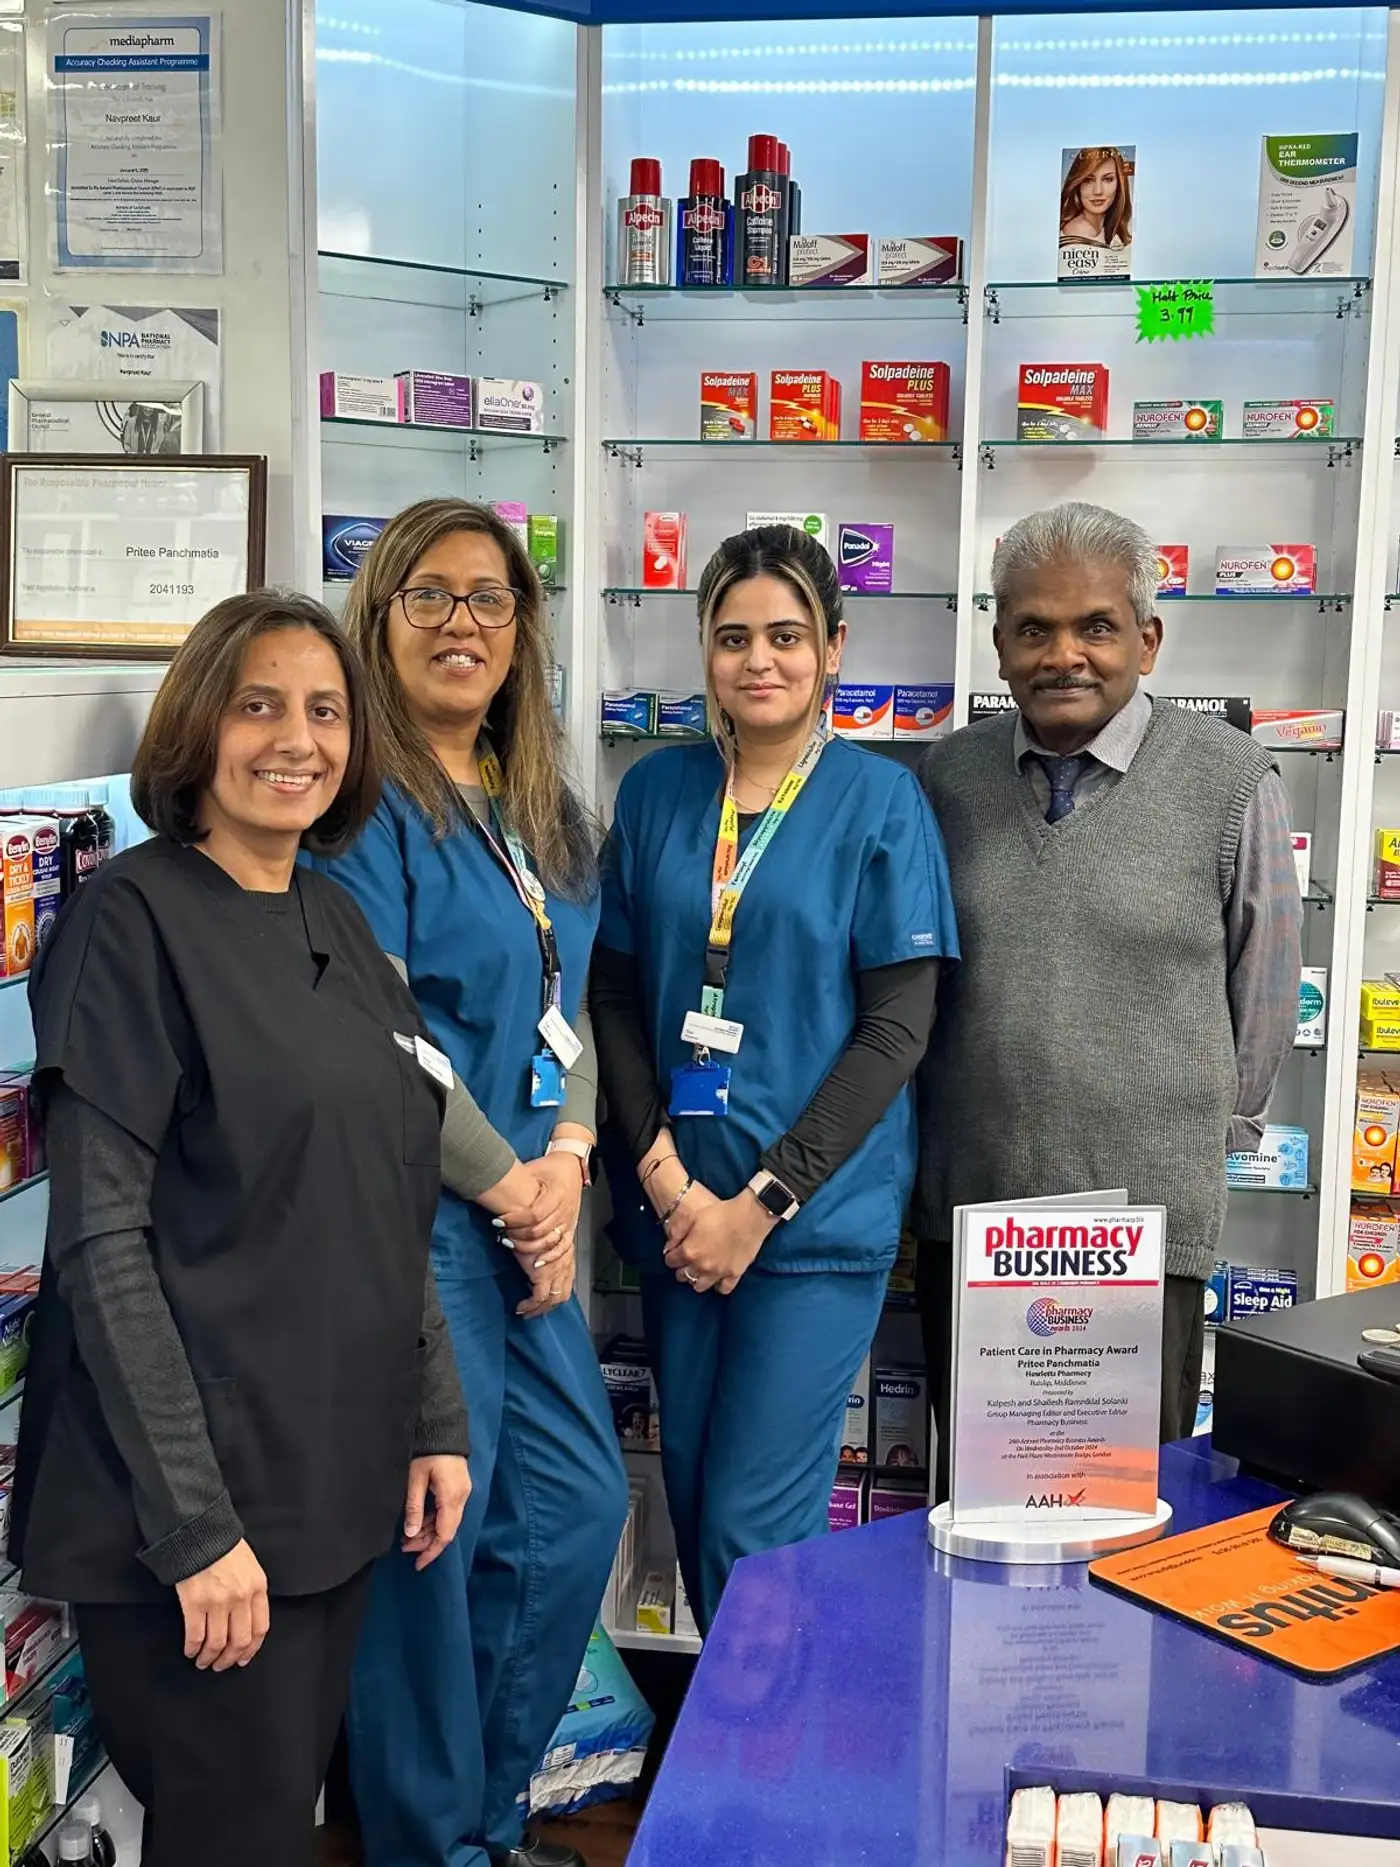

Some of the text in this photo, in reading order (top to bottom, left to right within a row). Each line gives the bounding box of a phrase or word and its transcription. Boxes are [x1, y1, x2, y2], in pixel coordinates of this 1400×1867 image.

[109, 35, 175, 48] mediapharm
[66, 57, 198, 67] Accuracy Checking Assistant Programme
[105, 114, 161, 124] Navpreet Kaur
[1278, 157, 1346, 167] THERMOMETER
[629, 211, 660, 226] Alpecin
[687, 212, 720, 226] Alpecin
[746, 227, 772, 236] Shampoo
[796, 248, 819, 257] protect
[885, 250, 907, 259] protect
[1067, 258, 1099, 269] easy
[1152, 289, 1214, 304] Half Price
[1160, 306, 1195, 325] 3.99
[108, 331, 140, 348] NPA
[141, 332, 171, 340] NATIONAL
[869, 364, 935, 382] Solpadeine
[1024, 369, 1095, 387] Solpadeine
[704, 376, 750, 388] Solpadeine
[775, 373, 822, 386] Solpadeine
[801, 384, 822, 393] PLUS
[907, 380, 934, 391] PLUS
[1070, 384, 1094, 395] MAX
[728, 387, 748, 397] MAX
[484, 395, 521, 408] ellaOne
[1136, 413, 1180, 422] NUROFEN
[1246, 413, 1292, 422] NUROFEN
[843, 542, 870, 550] Panadol
[126, 546, 219, 559] Pritee Panchmatia
[872, 561, 890, 569] Night
[1220, 561, 1267, 570] NUROFEN
[149, 584, 194, 595] 2041193
[835, 688, 877, 698] Paracetamol
[897, 688, 938, 698] Paracetamol
[973, 695, 1016, 709] PARAM
[1275, 722, 1328, 739] Veganin
[35, 834, 57, 847] Benylin
[8, 841, 30, 855] Benylin
[38, 856, 54, 868] DRY
[9, 865, 21, 875] DRY
[1300, 997, 1322, 1005] derm
[1372, 997, 1400, 1005] Ibuleve
[1376, 1026, 1400, 1035] Ibulev
[1226, 1152, 1278, 1164] Avomine
[1354, 1222, 1395, 1232] NUROFEN
[985, 1217, 1145, 1257] pharmacy
[993, 1250, 1128, 1277] BUSINESS
[1233, 1292, 1293, 1310] Sleep Aid
[1045, 1304, 1094, 1318] pharmacy
[1047, 1315, 1090, 1325] BUSINESS
[979, 1345, 1139, 1358] Patient Care in Pharmacy Award
[1017, 1358, 1100, 1368] Pritee Panchmatia
[1057, 1370, 1092, 1378] Pharmacy
[880, 1383, 914, 1395] Hedrin
[987, 1399, 1016, 1408] Kalpesh
[1017, 1399, 1032, 1407] and
[1033, 1398, 1063, 1407] Shailesh
[1101, 1397, 1128, 1406] Solanki
[987, 1408, 1128, 1419] Group Managing Editor and Executive Editor
[1027, 1418, 1088, 1428] Pharmacy Business
[1033, 1472, 1070, 1480] association
[1025, 1493, 1063, 1509] AAH
